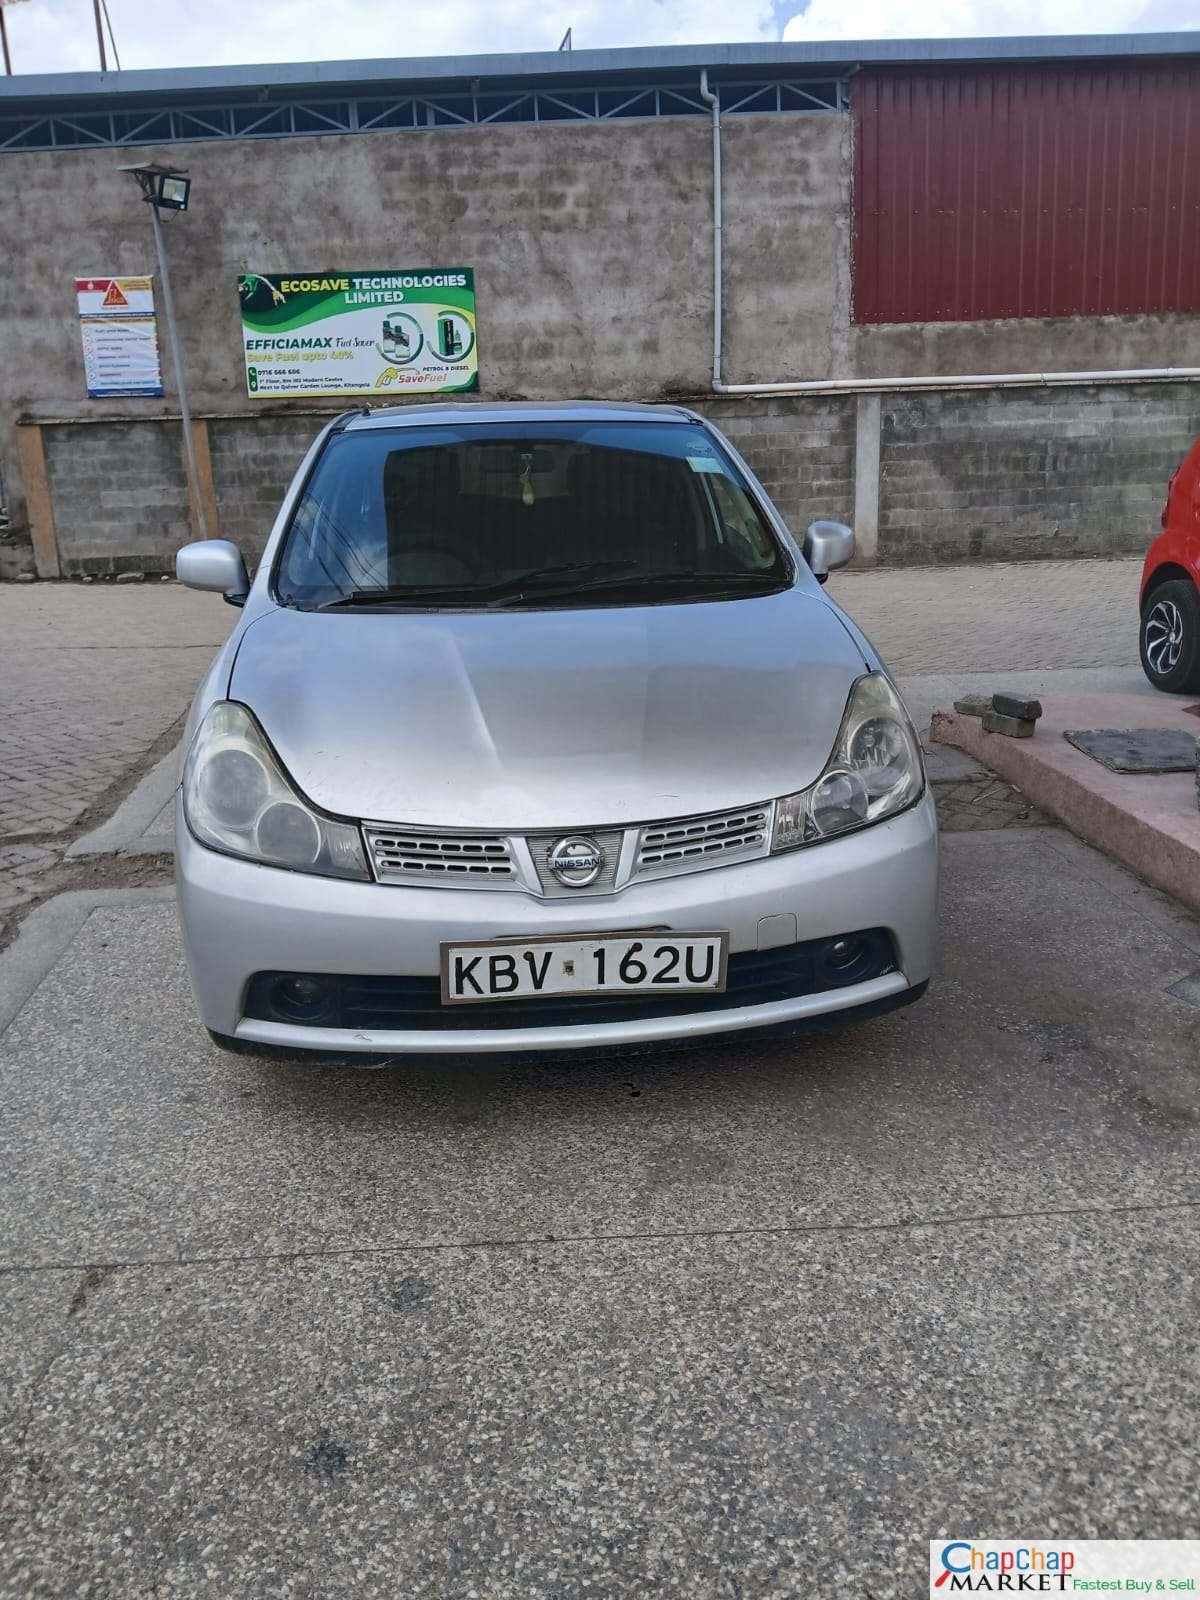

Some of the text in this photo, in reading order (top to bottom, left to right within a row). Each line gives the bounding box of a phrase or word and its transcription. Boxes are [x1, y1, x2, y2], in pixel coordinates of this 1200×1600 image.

[281, 275, 467, 292] ECOSAVE TECHNOLOGIES
[344, 291, 404, 304] LIMITED
[246, 337, 375, 350] EFFICIAMAX Fuel Saver
[275, 352, 300, 362] Fuel
[398, 373, 448, 384] SaveFuel
[554, 858, 600, 868] NISSAN
[454, 943, 714, 995] KBV 162U
